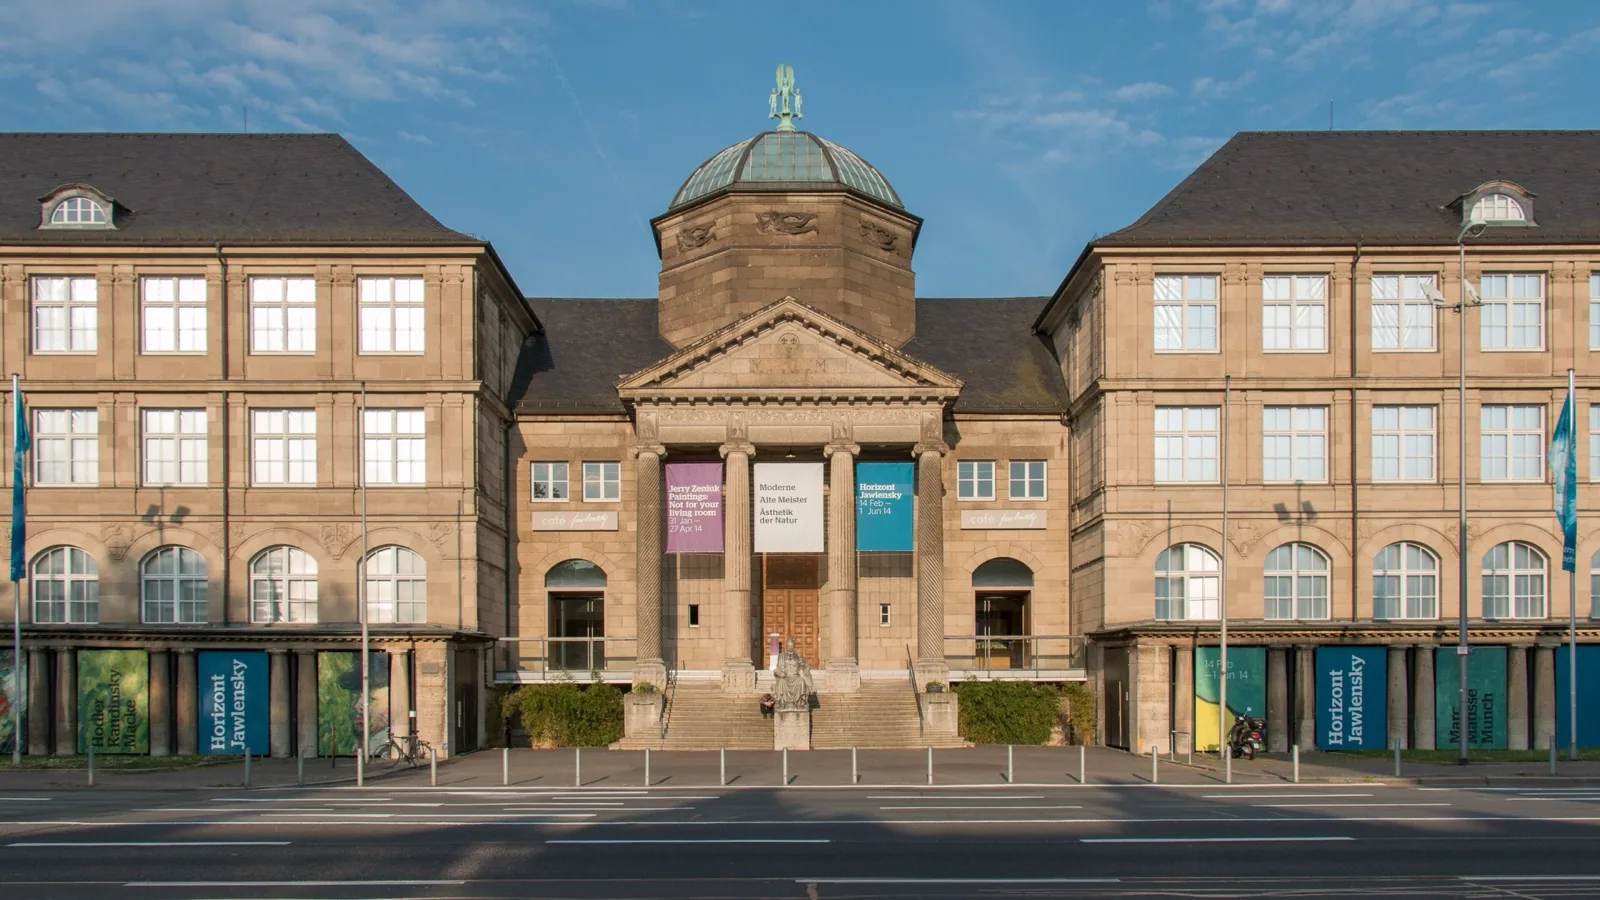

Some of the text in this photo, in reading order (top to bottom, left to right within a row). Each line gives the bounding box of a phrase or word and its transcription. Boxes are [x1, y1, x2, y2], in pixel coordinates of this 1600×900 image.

[669, 485, 690, 493] Jerry
[669, 493, 708, 501] Paintings:
[860, 492, 902, 500] Jawlensky
[669, 510, 692, 518] living
[760, 508, 794, 516] Ästhetik
[970, 512, 995, 524] café
[541, 514, 566, 526] café
[680, 526, 692, 534] Apr
[1204, 660, 1233, 668] 14 Fb
[1240, 670, 1248, 679] 14
[230, 659, 247, 750] Jawlensky
[1348, 654, 1365, 745] Jawlensky
[108, 669, 122, 747] Kandinsky
[210, 674, 225, 750] Horizont
[1328, 669, 1343, 745] Horizont
[92, 698, 104, 747] Hodler
[124, 699, 137, 748] Macke
[1481, 693, 1493, 744] Munch
[1450, 708, 1460, 744] Marc
